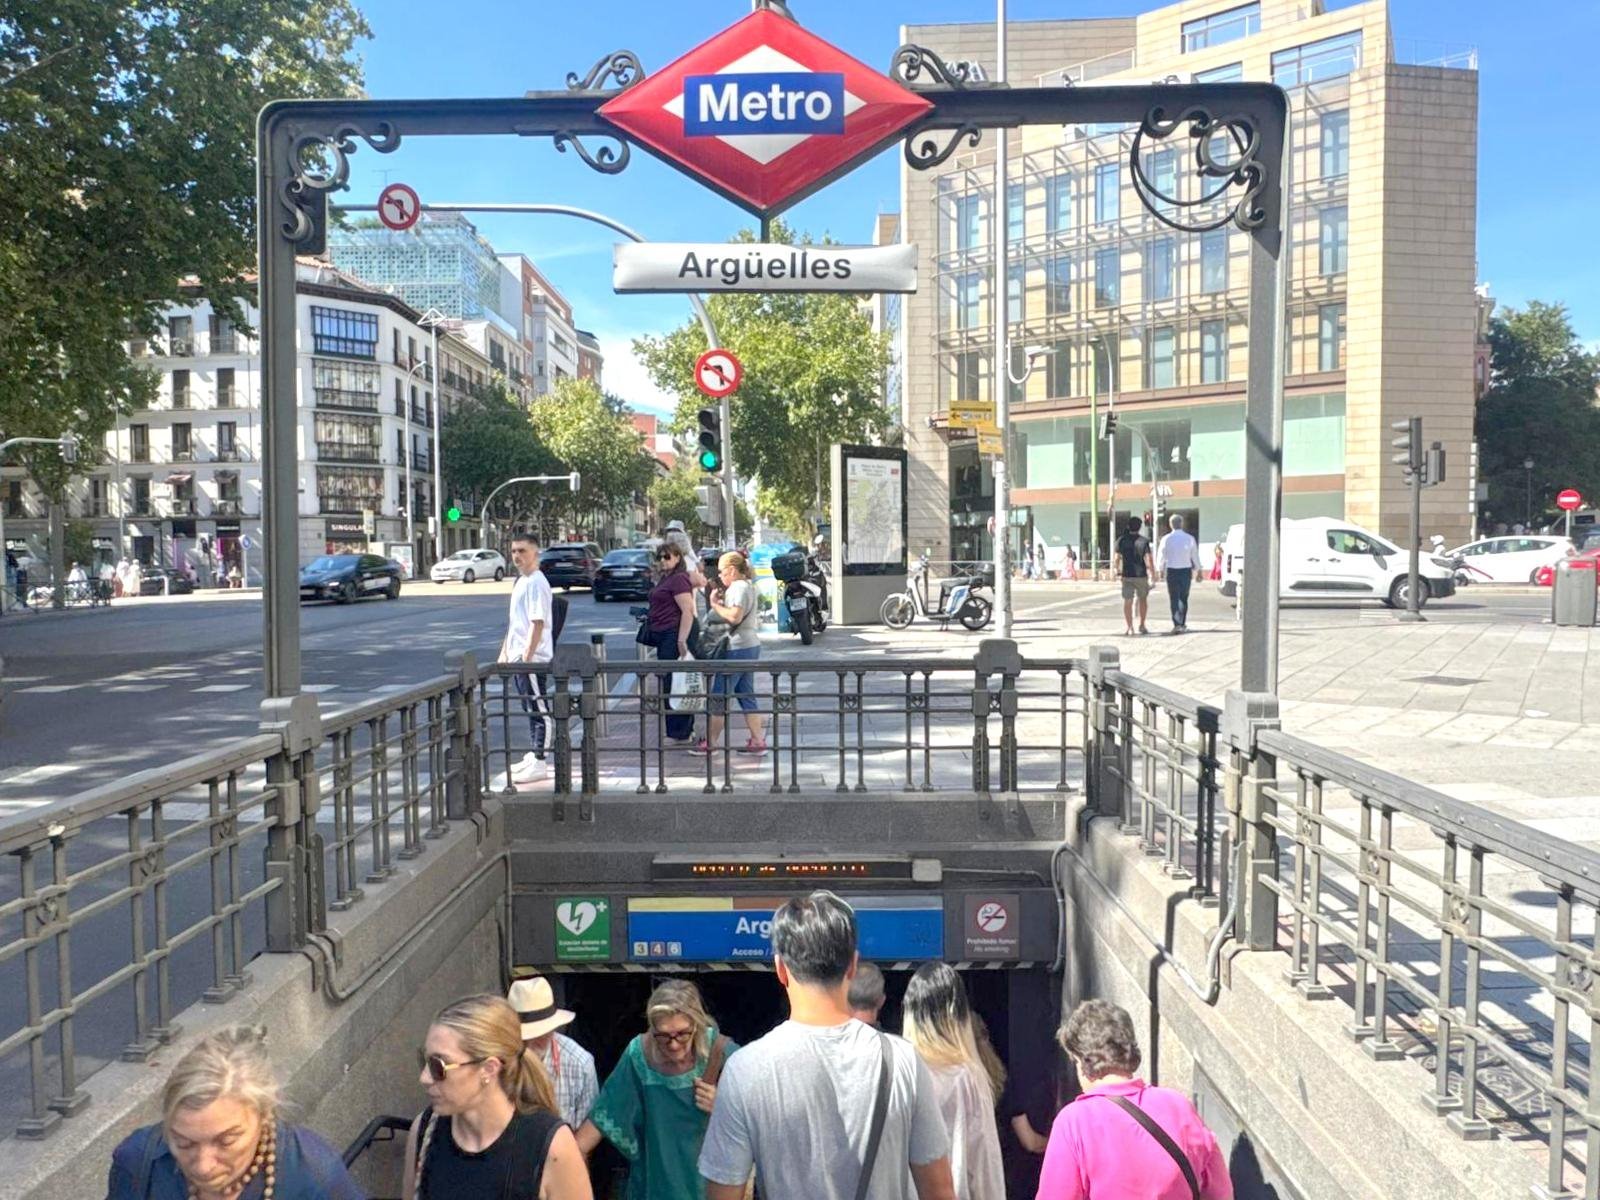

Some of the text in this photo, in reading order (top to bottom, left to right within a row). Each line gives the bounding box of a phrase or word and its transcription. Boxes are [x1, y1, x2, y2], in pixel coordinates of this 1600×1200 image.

[699, 82, 832, 122] Metro
[678, 251, 852, 285] Argüelles
[331, 523, 365, 532] SINGULA
[732, 948, 764, 956] Acceso
